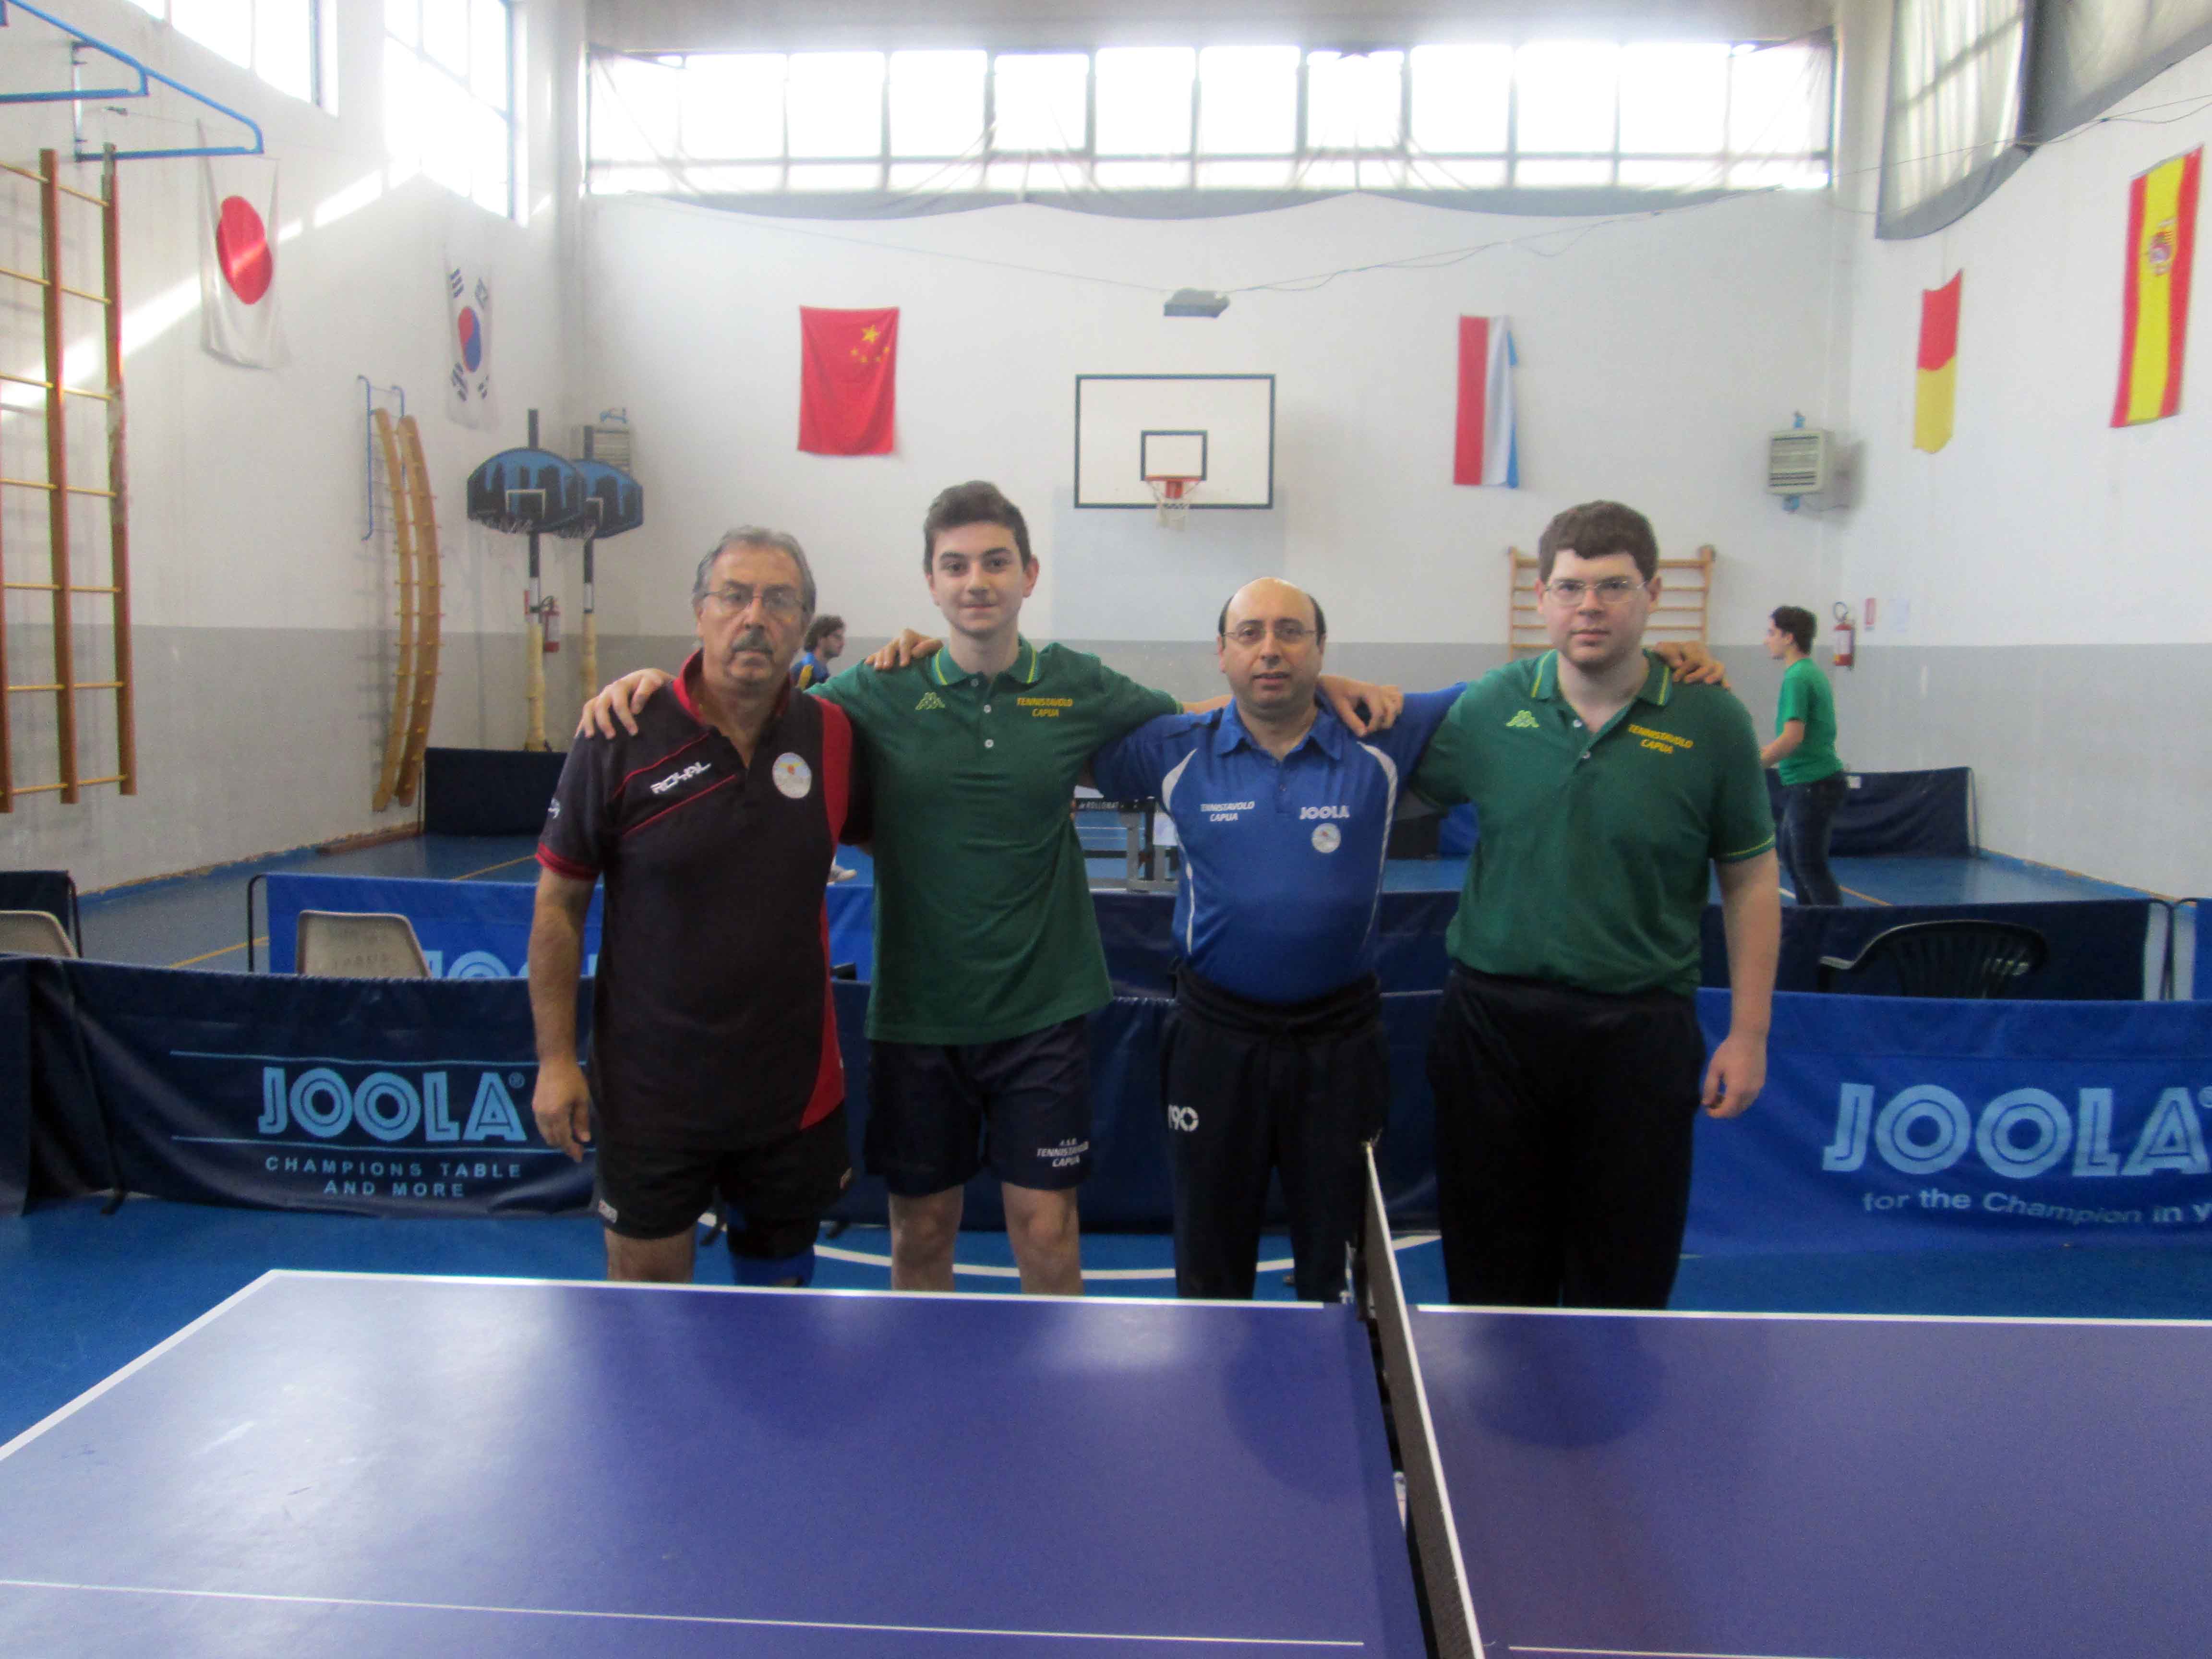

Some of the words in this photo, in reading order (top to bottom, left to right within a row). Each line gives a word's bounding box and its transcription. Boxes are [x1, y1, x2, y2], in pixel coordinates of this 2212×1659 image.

[1031, 708, 1060, 718] CAPUA
[1210, 813, 1238, 822] CAPUA
[1299, 805, 1350, 819] JOOLA
[258, 1066, 527, 1142] JOOLA
[1822, 1082, 2209, 1179] JOOLA
[265, 1157, 422, 1177] CHAMPIONS
[440, 1162, 521, 1178] TABLE
[324, 1180, 375, 1195] AND
[392, 1183, 464, 1197] MORE
[1863, 1192, 1910, 1211] for
[1920, 1188, 1971, 1209] the
[1983, 1192, 2142, 1226] Champion
[2153, 1206, 2183, 1223] in
